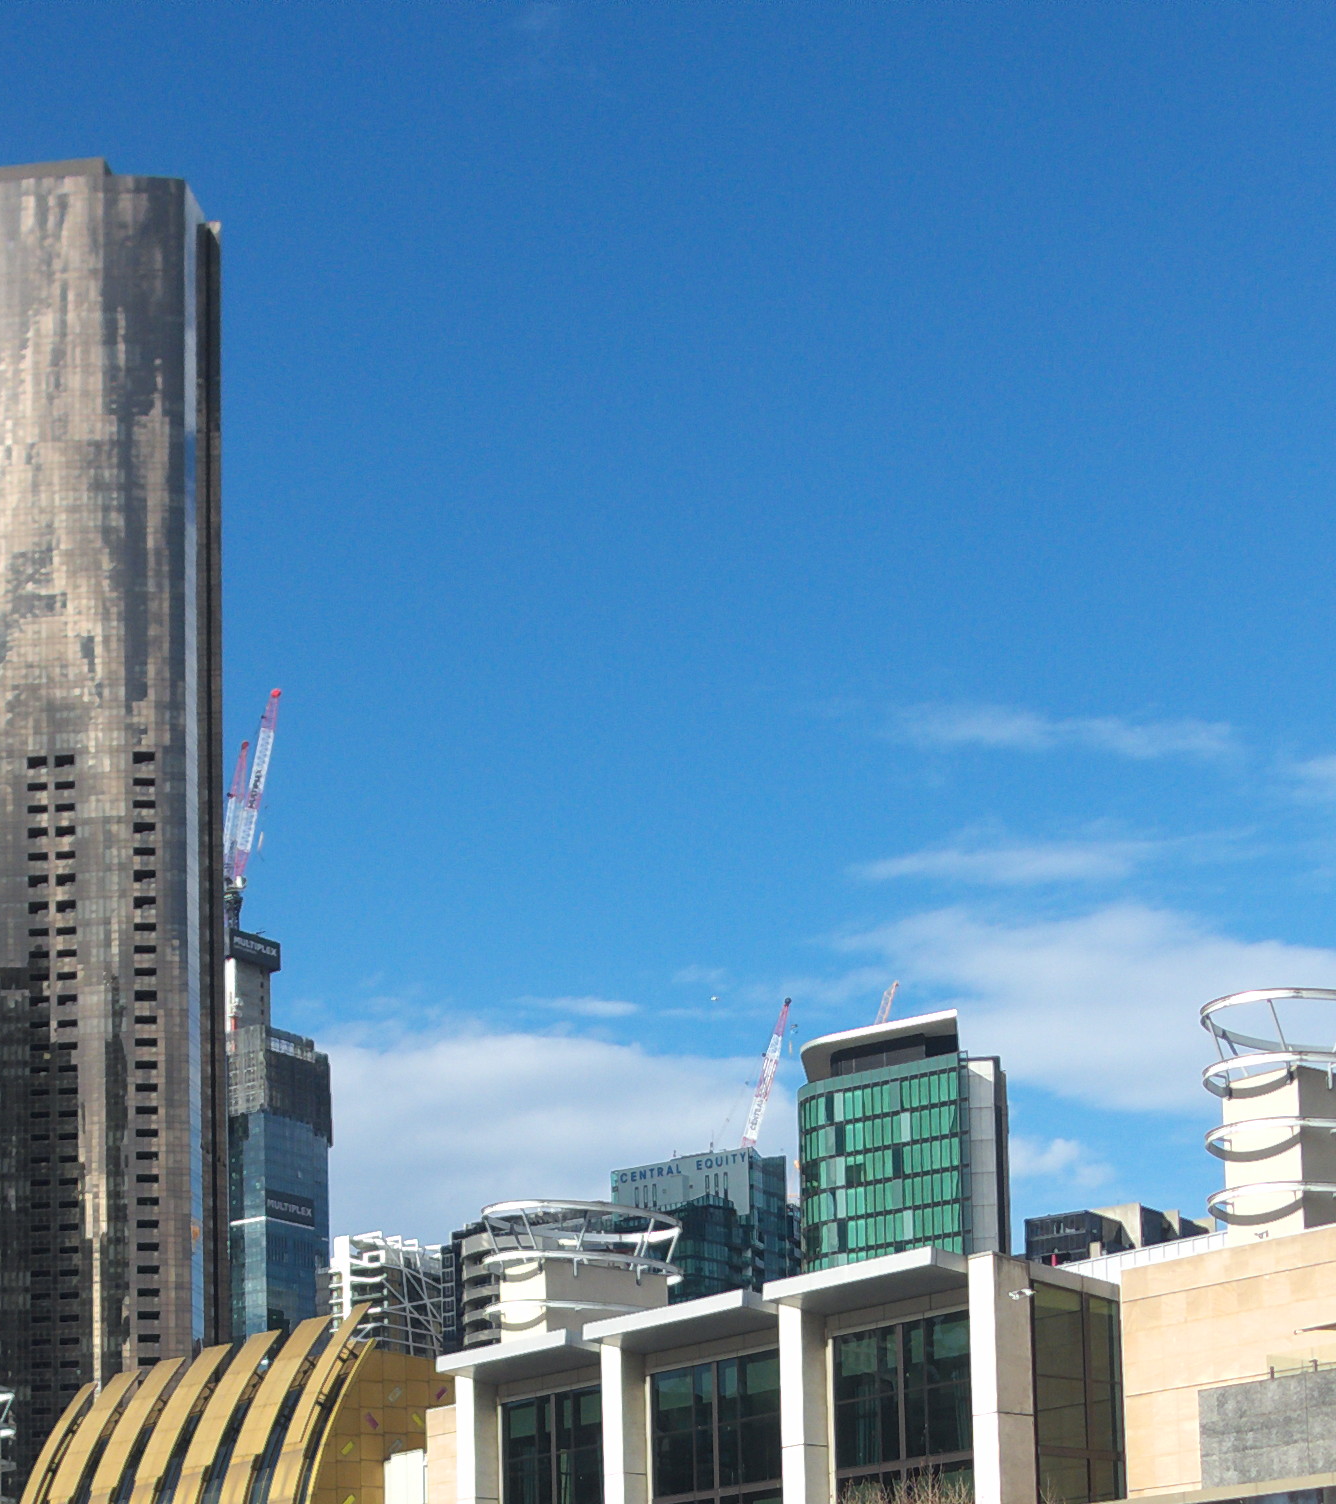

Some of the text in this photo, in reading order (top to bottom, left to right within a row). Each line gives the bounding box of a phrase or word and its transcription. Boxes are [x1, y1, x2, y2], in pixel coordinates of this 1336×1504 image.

[233, 935, 277, 957] MULTIPLEX
[619, 1151, 747, 1183] CENTRAL EQUITY
[266, 1198, 313, 1218] MULTIPLEX
